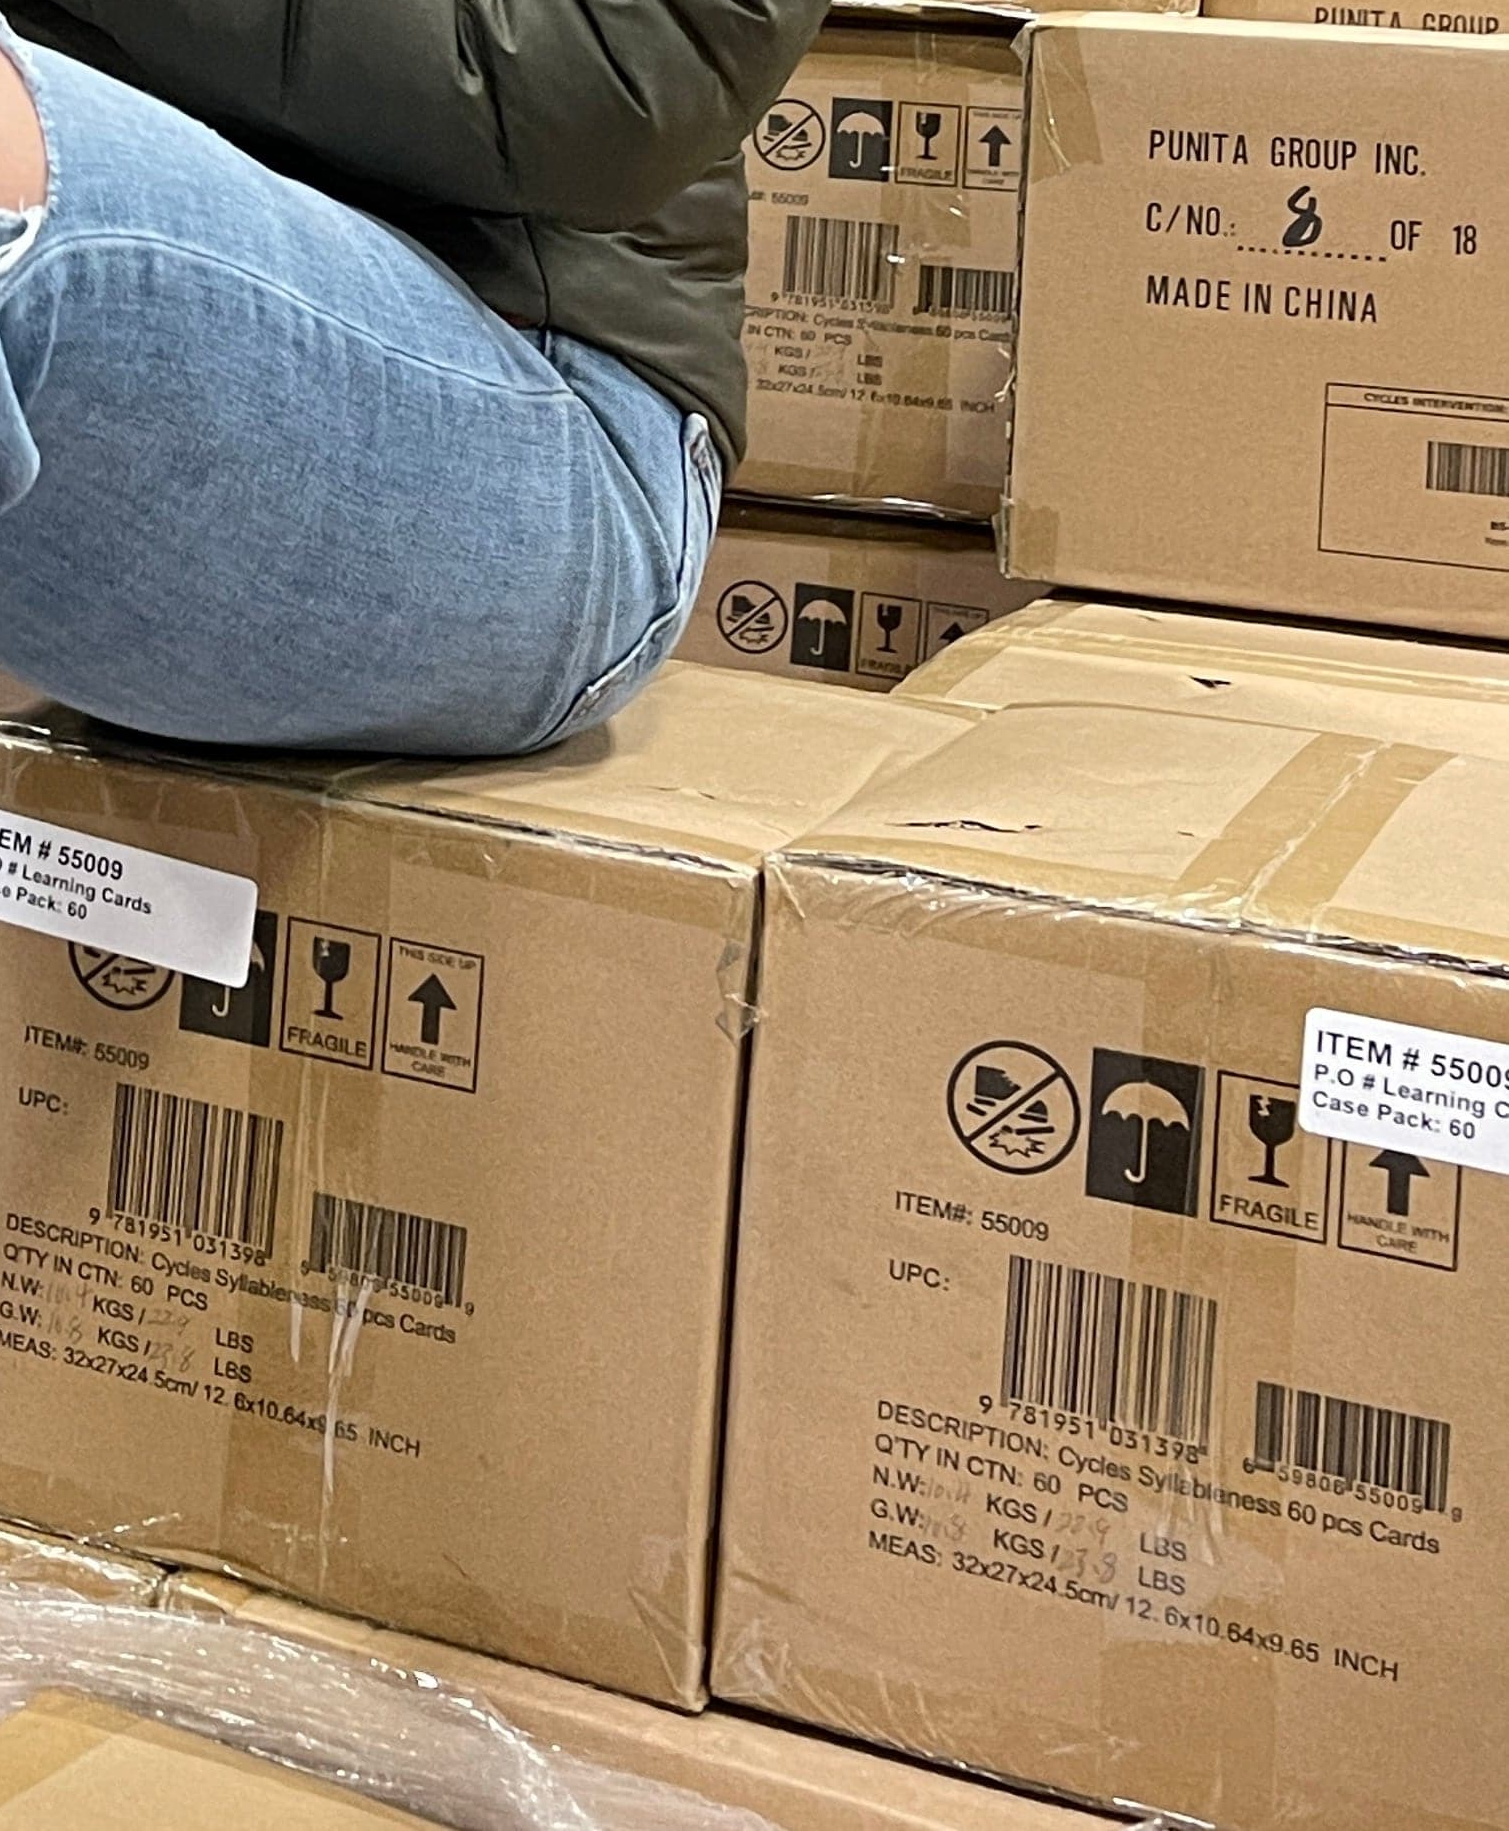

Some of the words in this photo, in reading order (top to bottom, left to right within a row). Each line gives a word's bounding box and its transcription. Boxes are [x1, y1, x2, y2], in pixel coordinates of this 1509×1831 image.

[1148, 129, 1249, 165] PUNITA
[1270, 136, 1357, 170] GROUP
[1374, 142, 1426, 177] INC.
[1145, 201, 1236, 237] C/NO.:
[1282, 185, 1323, 248] 8
[1389, 220, 1423, 251] OF
[1452, 224, 1477, 255] 18
[1145, 275, 1231, 311] MADE
[1244, 281, 1272, 314] IN
[1284, 286, 1377, 323] CHINA
[763, 326, 795, 341] CTN:
[824, 333, 852, 346] PCS
[774, 346, 803, 360] KGS
[778, 363, 808, 377] KGS
[856, 373, 883, 386] LBS
[1363, 392, 1409, 406] CYCLES
[37, 839, 52, 860] #
[57, 846, 123, 881] 55009
[7, 860, 19, 875] #
[22, 864, 96, 902] Learning
[102, 887, 152, 915] Cards
[15, 886, 61, 913] Pack:
[67, 901, 88, 920] 60
[399, 945, 425, 961] THIS
[426, 952, 455, 967] SIDE
[24, 1025, 88, 1055] ITEM#:
[94, 1042, 150, 1071] 55009
[287, 1026, 368, 1059] FRAGILE
[1316, 1030, 1392, 1067] ITEM
[1402, 1047, 1420, 1072] #
[18, 1086, 69, 1115] UPC:
[1312, 1090, 1370, 1117] Case
[1377, 1103, 1441, 1133] Pack:
[1448, 1119, 1476, 1139] 60
[1314, 1064, 1355, 1087] P.O
[1362, 1073, 1376, 1090] #
[1384, 1077, 1486, 1119] Learning
[89, 1207, 100, 1225] 9
[113, 1213, 183, 1247] 781951
[193, 1234, 267, 1267] 031398
[895, 1190, 973, 1227] ITEM#:
[980, 1210, 1050, 1242] 55009
[1219, 1194, 1320, 1232] FRAGILE
[1346, 1212, 1408, 1236] HANDLE
[1410, 1224, 1451, 1244] WITH
[1376, 1235, 1418, 1255] CARE
[6, 1213, 144, 1264] DESCRIPTION:
[151, 1252, 211, 1283] Cycles
[363, 1306, 395, 1328] pcs
[399, 1313, 456, 1345] Cards
[54, 1255, 72, 1276] IN
[77, 1261, 123, 1289] CTN:
[130, 1275, 154, 1297] 60
[166, 1285, 209, 1311] PCS
[889, 1258, 950, 1292] UPC:
[93, 1295, 134, 1322] KGS
[215, 1327, 254, 1354] LBS
[97, 1326, 139, 1354] KGS
[214, 1357, 252, 1384] LBS
[368, 1427, 422, 1459] INCH
[978, 1394, 993, 1414] 9
[1009, 1401, 1094, 1439] 781951
[1109, 1426, 1200, 1464] 031398
[877, 1400, 1049, 1460] DESCRIPTION:
[1058, 1445, 1131, 1482] Cycles
[1138, 1465, 1282, 1516] Syllableness
[1287, 1500, 1317, 1525] 60
[1322, 1513, 1364, 1537] pcs
[1369, 1521, 1441, 1554] Cards
[936, 1447, 960, 1471] IN
[966, 1456, 1023, 1487] CTN:
[1033, 1472, 1061, 1495] 60
[1078, 1483, 1129, 1513] PCS
[1242, 1456, 1255, 1474] 6
[1278, 1470, 1346, 1496] 59806
[1353, 1486, 1424, 1515] 55009
[986, 1492, 1038, 1524] KGS
[1139, 1531, 1188, 1562] LBS
[993, 1528, 1045, 1559] KGS
[1138, 1565, 1187, 1596] LBS
[868, 1530, 943, 1567] MEAS:
[1333, 1648, 1399, 1682] INCH
